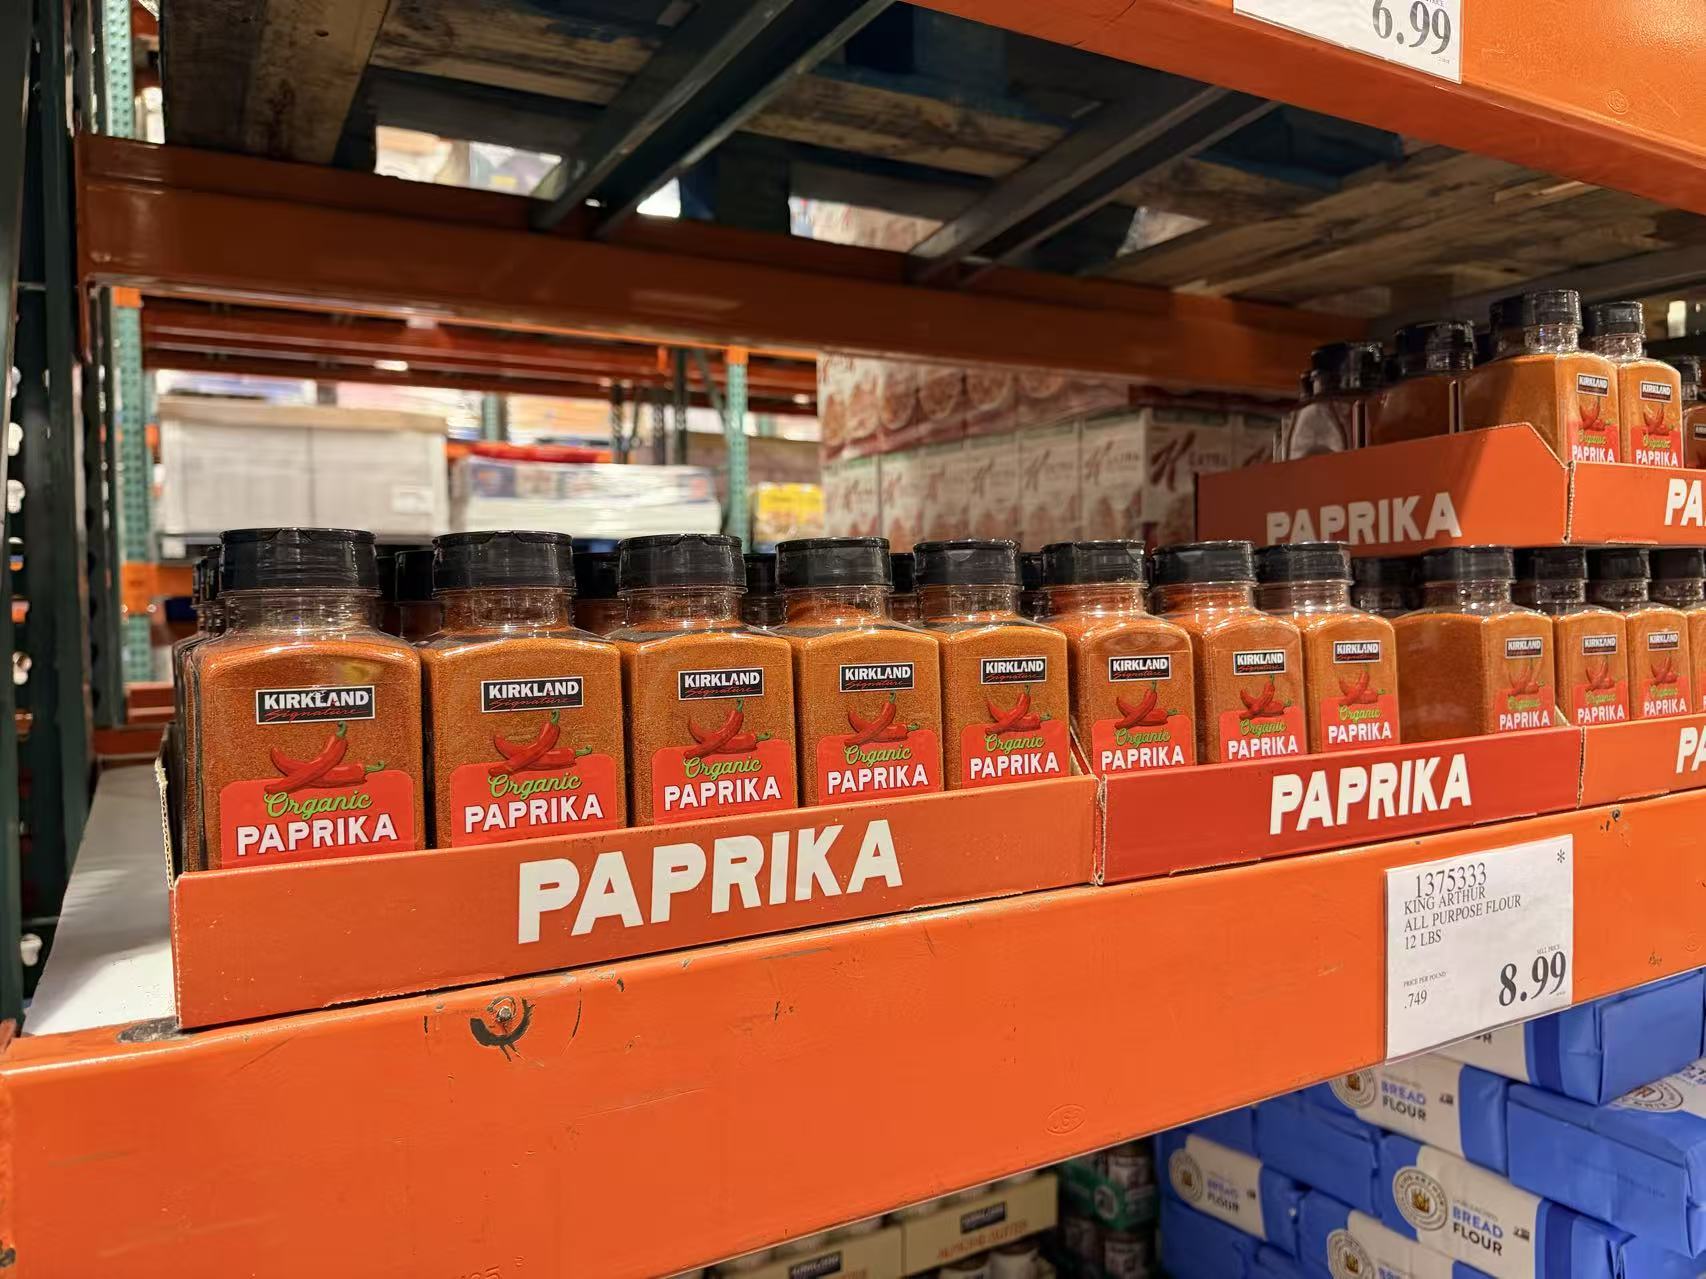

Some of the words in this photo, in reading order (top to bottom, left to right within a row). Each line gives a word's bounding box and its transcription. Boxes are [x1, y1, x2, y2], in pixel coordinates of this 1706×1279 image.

[1373, 0, 1451, 54] 6.99
[1579, 375, 1608, 389] KIRKLAND
[1642, 384, 1671, 396] KIRKLAND
[1572, 444, 1615, 464] PAPRIKA
[1635, 449, 1679, 467] PAPRIKA
[1664, 478, 1706, 527] PA
[1266, 492, 1463, 546] PAPRIKA
[1337, 643, 1378, 654] KIRKLAND
[1507, 640, 1541, 650] KIRKLAND
[1584, 637, 1616, 648] KIRKLAND
[1649, 633, 1678, 643] KIRKLAND
[985, 660, 1044, 674] KIRKLAND
[1113, 659, 1168, 671] KIRKLAND
[1236, 653, 1283, 666] KIRKLAND
[684, 672, 760, 688] KIRKLAND
[845, 667, 911, 681] KIRKLAND
[264, 690, 370, 710] KIRKLAND
[489, 681, 579, 699] KIRKLAND
[264, 708, 369, 722] Signature
[1577, 704, 1625, 724] PAPRIKA
[1643, 697, 1688, 717] PAPRIKA
[1499, 709, 1551, 731] PAPRIKA
[984, 733, 1045, 754] Organic
[1114, 728, 1171, 748] Organic
[1327, 721, 1392, 744] PAPRIKA
[844, 744, 912, 768] Organic
[1101, 745, 1185, 771] PAPRIKA
[1227, 735, 1299, 760] PAPRIKA
[1676, 725, 1706, 774] PA
[683, 756, 762, 780] Organic
[969, 751, 1060, 780] PAPRIKA
[488, 772, 582, 800] Organic
[827, 763, 929, 795] PAPRIKA
[263, 790, 373, 820] Organic
[664, 776, 782, 811] PAPRIKA
[1269, 753, 1472, 836] PAPRIKA
[464, 793, 604, 834] PAPRIKA
[236, 813, 399, 857] PAPRIKA
[517, 819, 904, 946] PAPRIKA
[1415, 862, 1487, 898] 1375333
[1404, 896, 1435, 915] KING
[1438, 886, 1486, 908] ARTHUR
[1404, 915, 1429, 932] ALL
[1432, 902, 1483, 927] PURPOSE
[1485, 895, 1521, 914] FLOUR
[1405, 934, 1416, 950] 12
[1420, 929, 1442, 947] LBS
[1499, 951, 1566, 1006] 8.99
[1404, 989, 1428, 1009] .749
[1381, 1079, 1426, 1105] BREAD
[1382, 1095, 1426, 1121] FLOUR
[1452, 1205, 1503, 1239] BREAD
[1453, 1221, 1502, 1256] FLOUR
